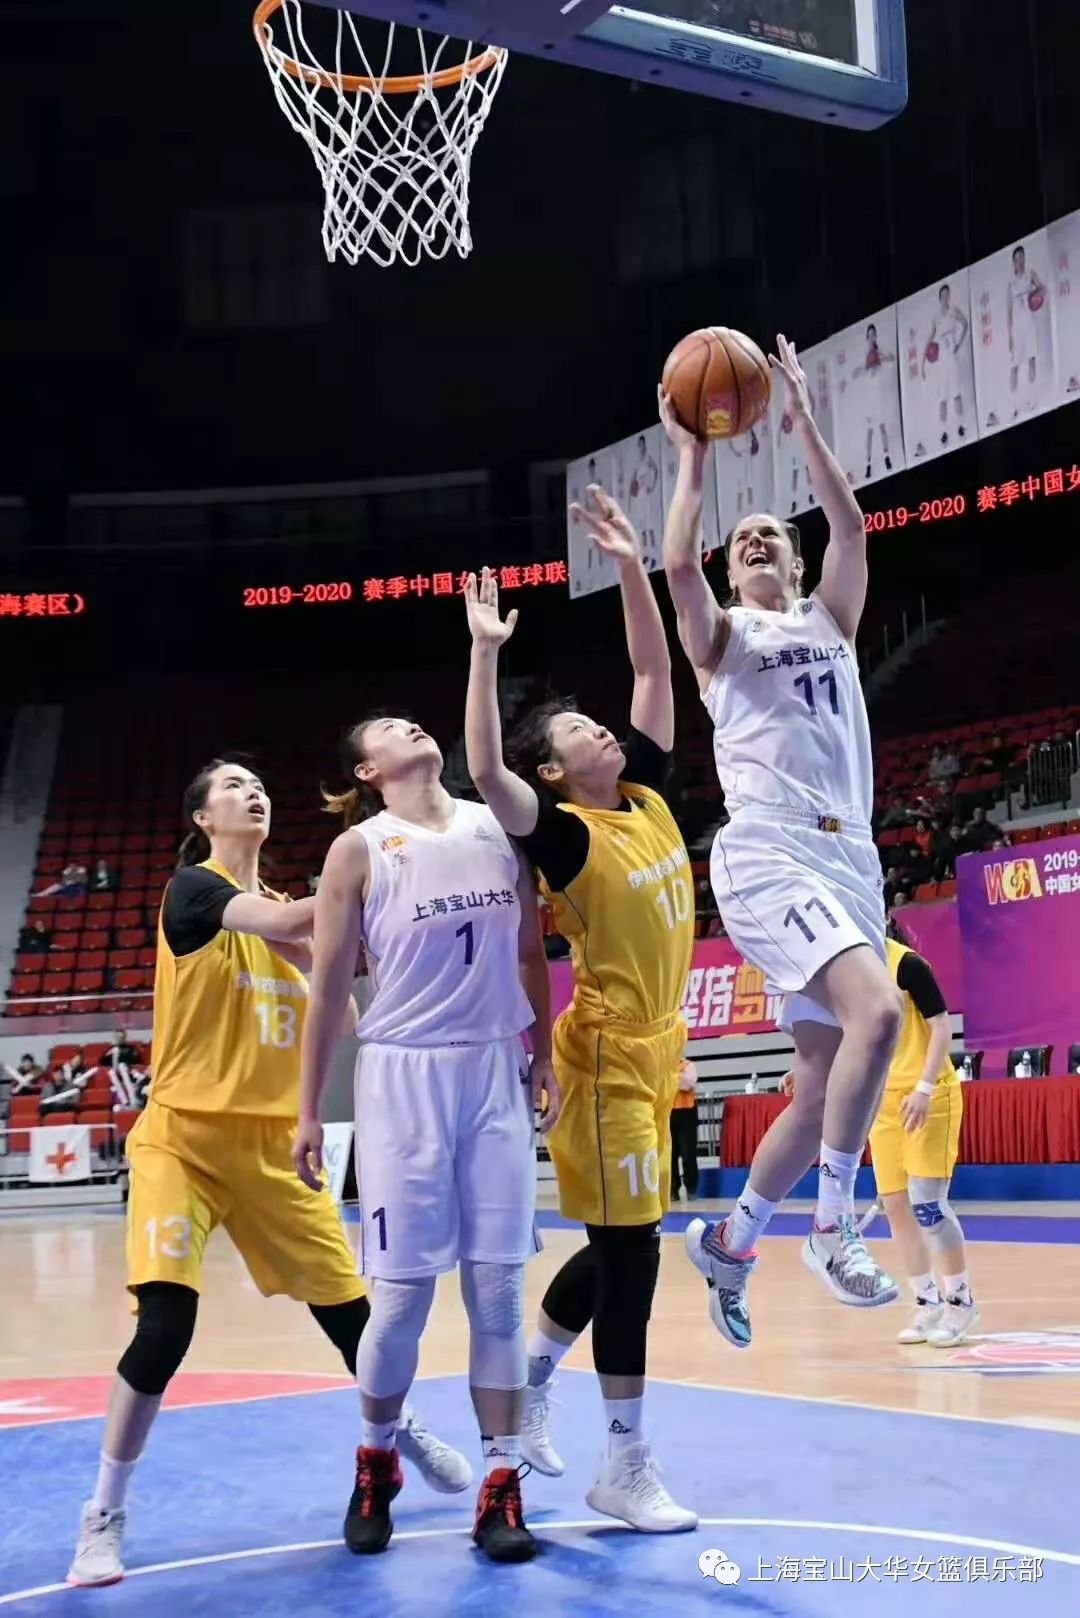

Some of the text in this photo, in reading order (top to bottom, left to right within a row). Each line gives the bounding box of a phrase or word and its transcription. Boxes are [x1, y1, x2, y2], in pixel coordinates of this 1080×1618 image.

[864, 464, 1080, 532] 2019-2020 赛季中国女
[243, 582, 352, 606] 2019-2020
[363, 560, 567, 602] 赛季中国女篮球联
[793, 670, 839, 716] 11
[412, 889, 515, 922] 上海宝山大华
[656, 877, 690, 929] 10
[784, 897, 839, 943] 11
[455, 921, 474, 965] 1
[255, 1003, 297, 1049] 13
[618, 1149, 659, 1197] 10
[144, 1215, 192, 1260] 13
[372, 1206, 387, 1251] 1
